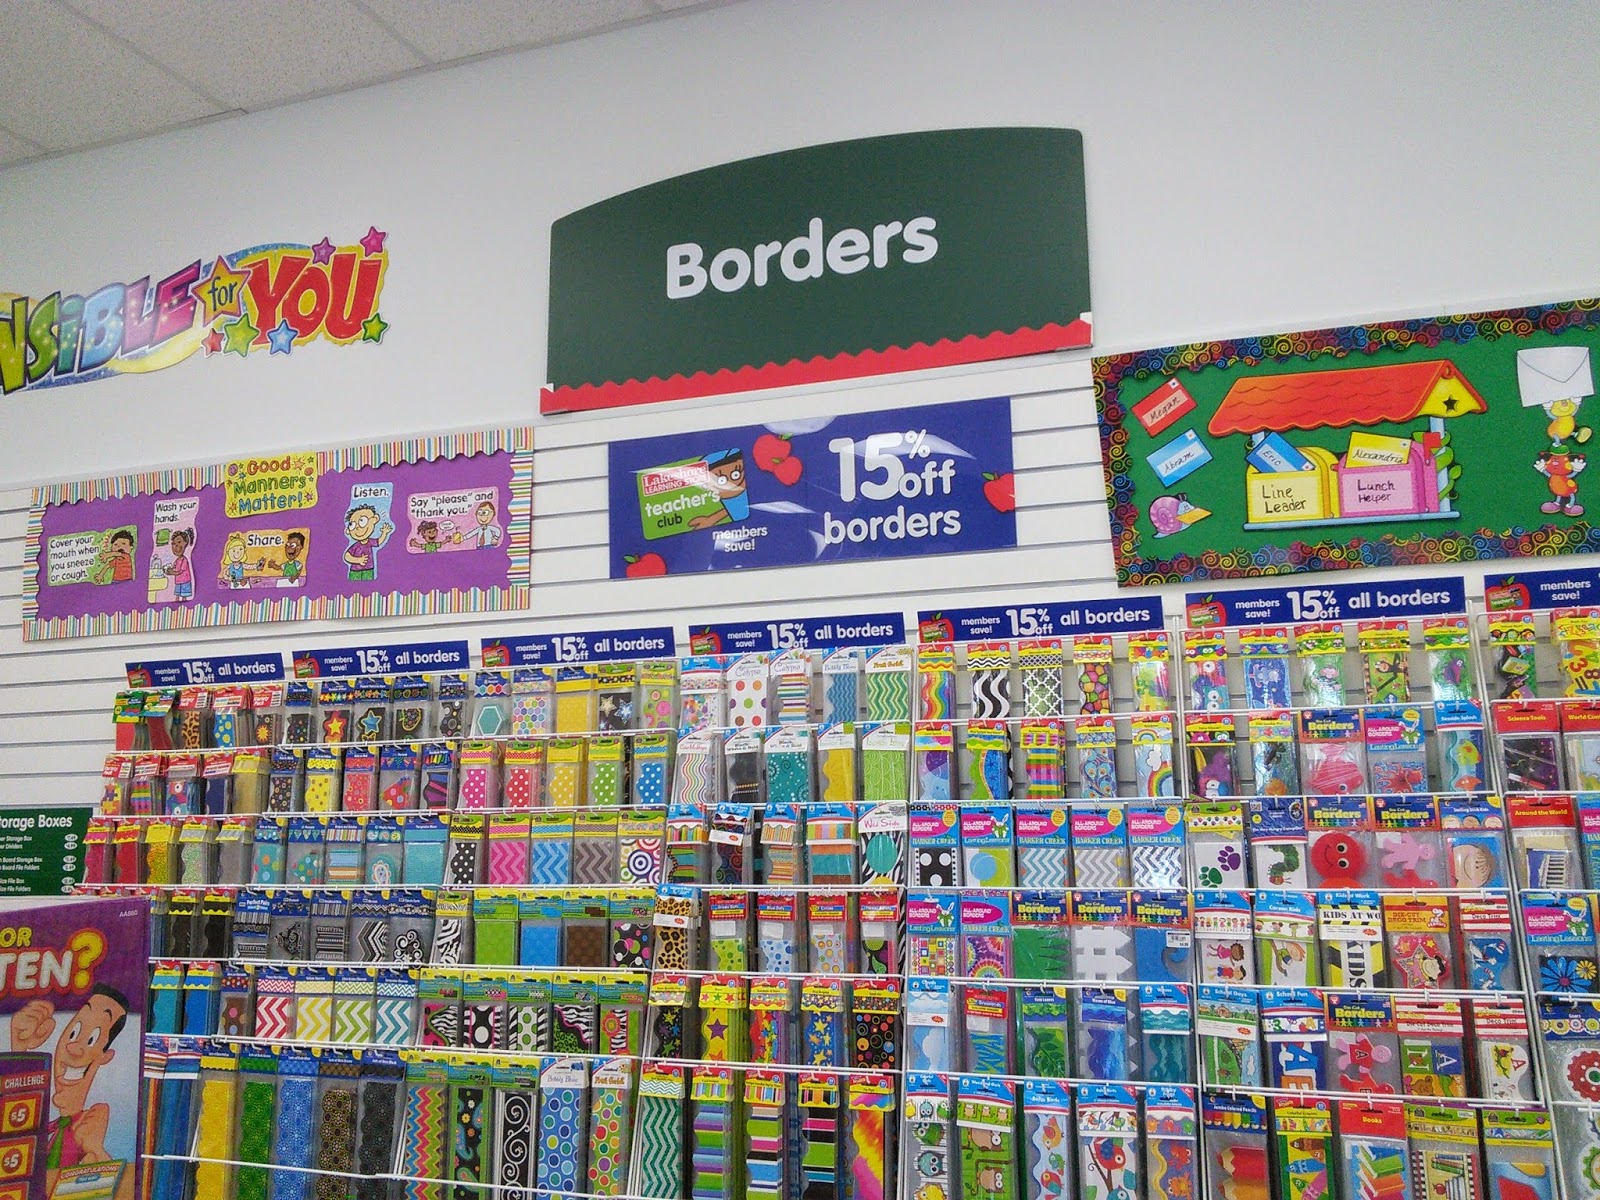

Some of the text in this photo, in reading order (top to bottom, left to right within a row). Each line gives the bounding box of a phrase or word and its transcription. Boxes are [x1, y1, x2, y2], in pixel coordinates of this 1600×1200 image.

[666, 216, 938, 300] Borders
[208, 276, 238, 312] for
[242, 253, 382, 346] YOU
[1150, 396, 1181, 422] Megan
[1164, 449, 1195, 472] Abram
[1261, 449, 1282, 467] Eric
[247, 456, 291, 474] Good
[642, 462, 709, 488] Lakeshore
[898, 459, 956, 495] off
[233, 475, 307, 499] Manners
[644, 473, 709, 496] LEARNING STORE
[1357, 479, 1395, 492] Lunch
[353, 487, 389, 498] Listen.
[1261, 484, 1293, 500] Line
[1358, 492, 1392, 504] Helper
[238, 492, 303, 514] Matter!
[411, 497, 428, 508] Say
[474, 490, 493, 501] and
[644, 489, 721, 517] teacher's
[156, 502, 196, 515] Wash your
[1265, 498, 1307, 514] Leader
[155, 514, 180, 524] hands.
[657, 511, 683, 529] club
[824, 506, 962, 544] borders
[711, 526, 768, 541] members
[50, 537, 93, 549] Cover your
[247, 534, 284, 547] Share.
[724, 539, 756, 552] save!
[50, 545, 99, 560] mouth when
[50, 557, 94, 572] you sneeze
[50, 567, 88, 582] or cough.
[1540, 580, 1591, 591] members
[1551, 590, 1581, 601] save!
[1235, 598, 1280, 609] members
[1318, 606, 1340, 619] off
[1349, 592, 1370, 609] all
[1376, 589, 1450, 608] borders
[1245, 609, 1271, 619] save!
[961, 616, 1000, 626] members
[1034, 624, 1054, 635] off
[1060, 611, 1080, 626] all
[1085, 607, 1150, 624] borders
[727, 631, 762, 640] members
[791, 639, 809, 648] off
[815, 627, 833, 641] all
[836, 623, 894, 639] borders
[970, 626, 993, 635] save!
[516, 643, 547, 653] members
[575, 651, 589, 661] off
[594, 639, 610, 653] all
[614, 637, 665, 652] borders
[735, 639, 755, 648] save!
[324, 656, 353, 665] members
[376, 662, 391, 673] off
[395, 652, 410, 665] all
[413, 650, 460, 664] borders
[523, 652, 541, 660] save!
[154, 667, 180, 676] members
[202, 673, 215, 684] off
[218, 662, 232, 676] all
[234, 662, 276, 675] borders
[331, 664, 348, 672] save!
[161, 674, 176, 682] save!
[1507, 714, 1530, 722] Science
[1308, 721, 1354, 731] Borders
[1313, 810, 1361, 819] Borders
[1381, 810, 1429, 819] Borders
[38, 815, 73, 828] Boxes
[1017, 904, 1061, 914] Borders
[1078, 904, 1122, 914] Borders
[1137, 905, 1182, 916] Borders
[1323, 910, 1363, 919] KIDS AT
[1233, 990, 1248, 998] Days
[1296, 990, 1308, 998] Fun
[1335, 1008, 1385, 1018] Borders
[4, 1074, 45, 1089] CHALLENGE
[11, 1107, 26, 1122] $5
[1362, 1116, 1382, 1124] Books
[3, 1153, 19, 1168] $5
